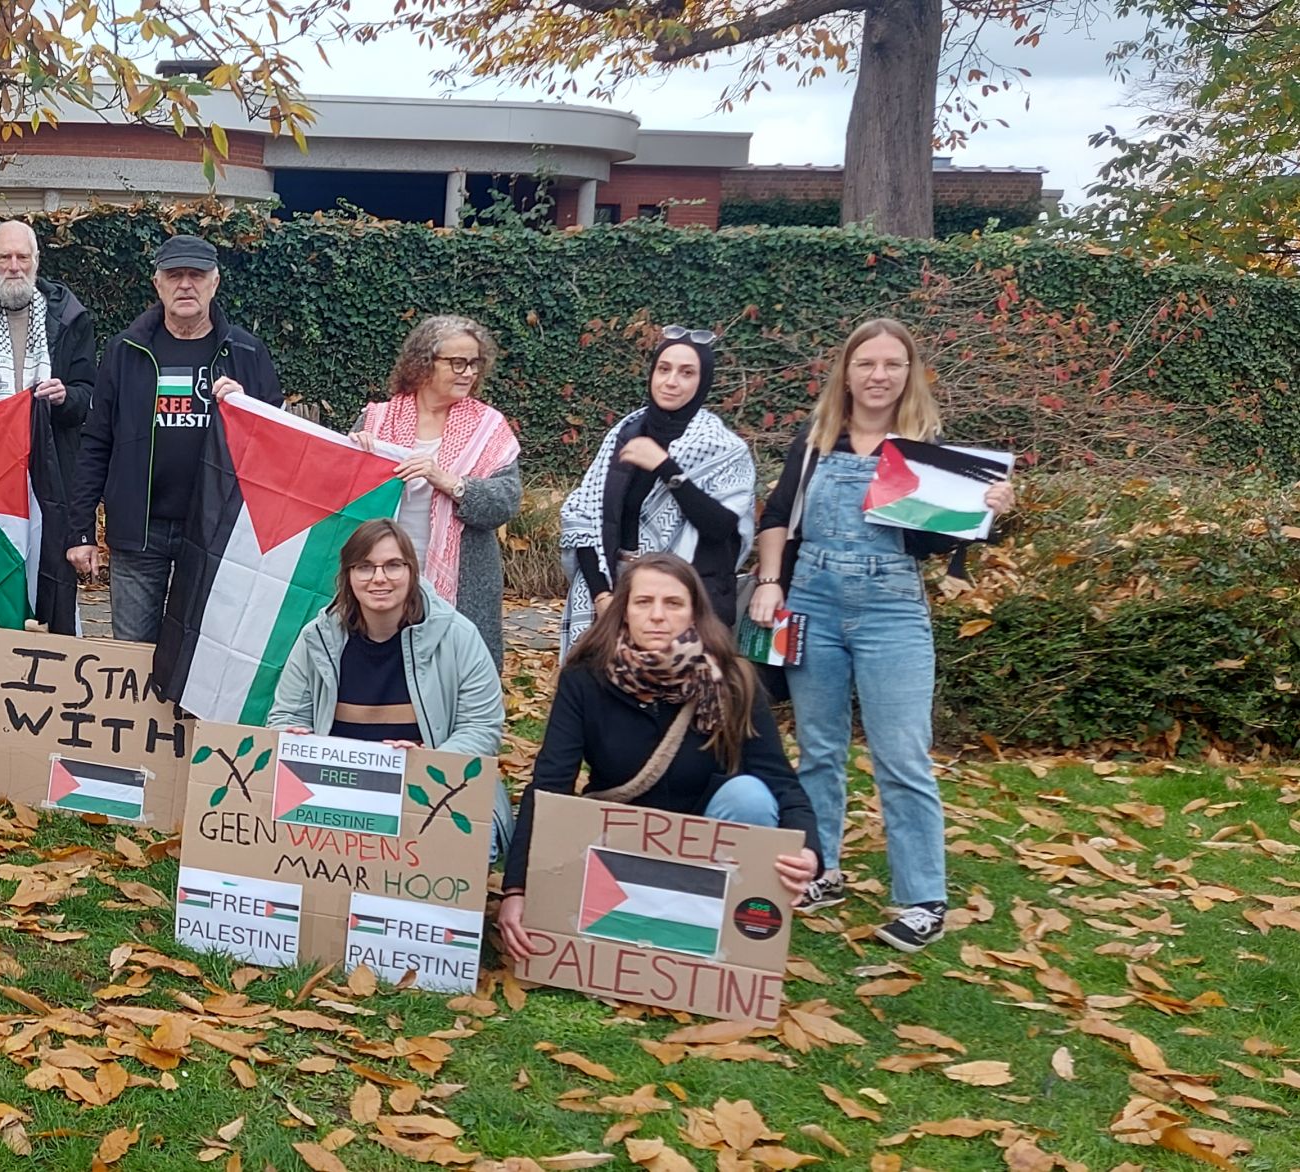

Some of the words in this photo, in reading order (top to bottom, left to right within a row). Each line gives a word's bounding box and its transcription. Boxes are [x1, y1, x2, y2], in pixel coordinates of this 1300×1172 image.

[155, 413, 211, 428] ALESTI
[156, 397, 192, 413] REE
[0, 647, 68, 694] I
[61, 654, 197, 721] STAN
[4, 697, 186, 758] WITH
[281, 742, 318, 759] FREE
[320, 747, 402, 769] PALESTINE
[320, 768, 358, 786] FREE
[296, 808, 376, 831] PALESTINE
[599, 807, 750, 866] FREE
[199, 810, 278, 846] GEEN
[286, 823, 420, 868] WAPENS
[274, 854, 370, 891] MAAR
[384, 870, 471, 904] HOOP
[210, 891, 266, 918] FREE
[178, 917, 297, 954] PALESTINE
[383, 918, 445, 944] FREE
[349, 945, 476, 981] PALESTINE
[524, 931, 784, 1023] PALESTINE
